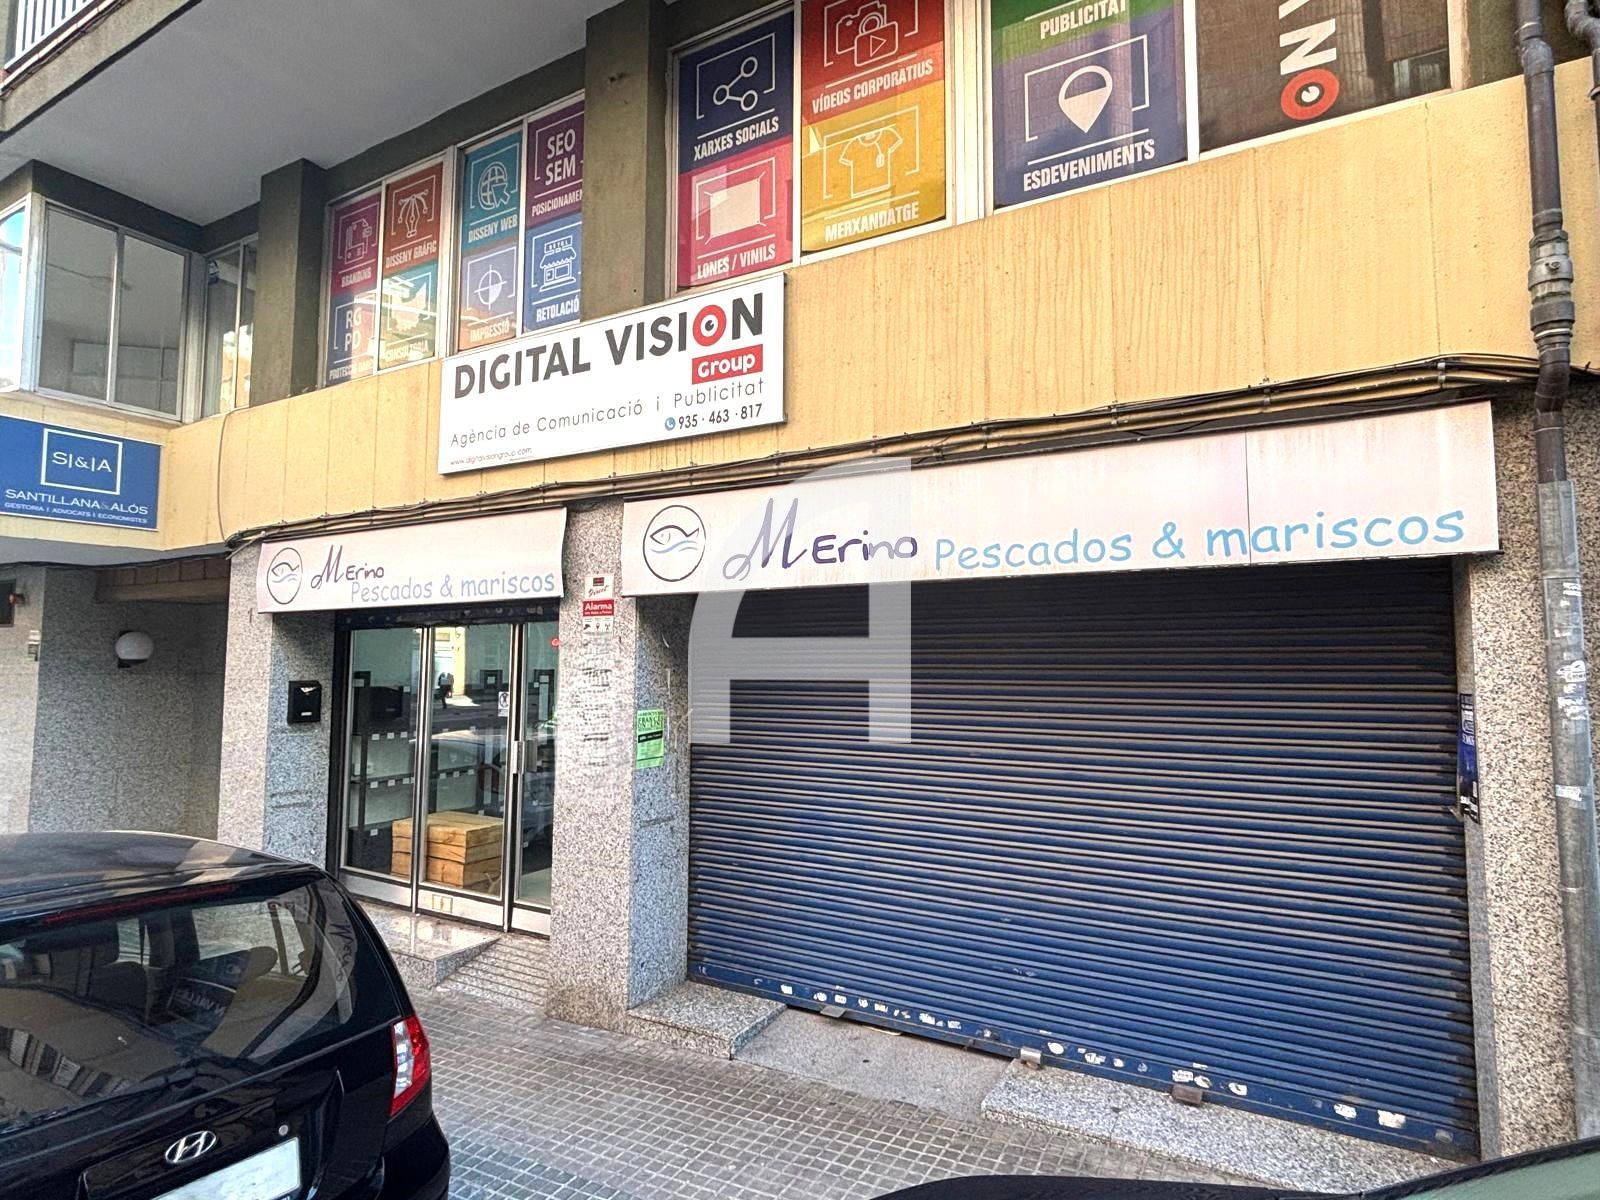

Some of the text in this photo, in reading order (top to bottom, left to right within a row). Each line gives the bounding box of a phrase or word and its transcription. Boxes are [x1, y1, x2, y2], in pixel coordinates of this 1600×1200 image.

[812, 59, 933, 115] VÍDEOS CORPORATIUS
[547, 129, 576, 159] SEO
[694, 117, 779, 162] XARXES SOCIALS
[545, 154, 576, 186] SEM
[1023, 138, 1155, 192] ESDEVENIMENTS
[468, 214, 518, 243] DISSENY WEB
[825, 201, 919, 242] MERXANDATGE
[385, 248, 412, 269] DISSENY
[697, 254, 729, 279] LONES
[739, 244, 776, 269] VINILS
[345, 307, 362, 329] RG
[536, 295, 580, 322] RETOLACIÓ
[344, 331, 362, 352] PD
[454, 292, 764, 399] DIGITAL VISION
[697, 353, 756, 379] Group
[450, 378, 765, 449] Agència de Comunicació i Publicitat
[679, 412, 698, 429] 935
[709, 408, 730, 425] 463
[740, 403, 762, 420] 817
[4, 502, 44, 512] GESTORIA
[52, 507, 91, 518] ADVOCATS
[98, 512, 147, 524] ECONOMISTES
[935, 509, 1466, 571] Pescados & mariscos
[351, 570, 555, 604] Pescados & mariscos
[585, 602, 612, 611] Alarma
